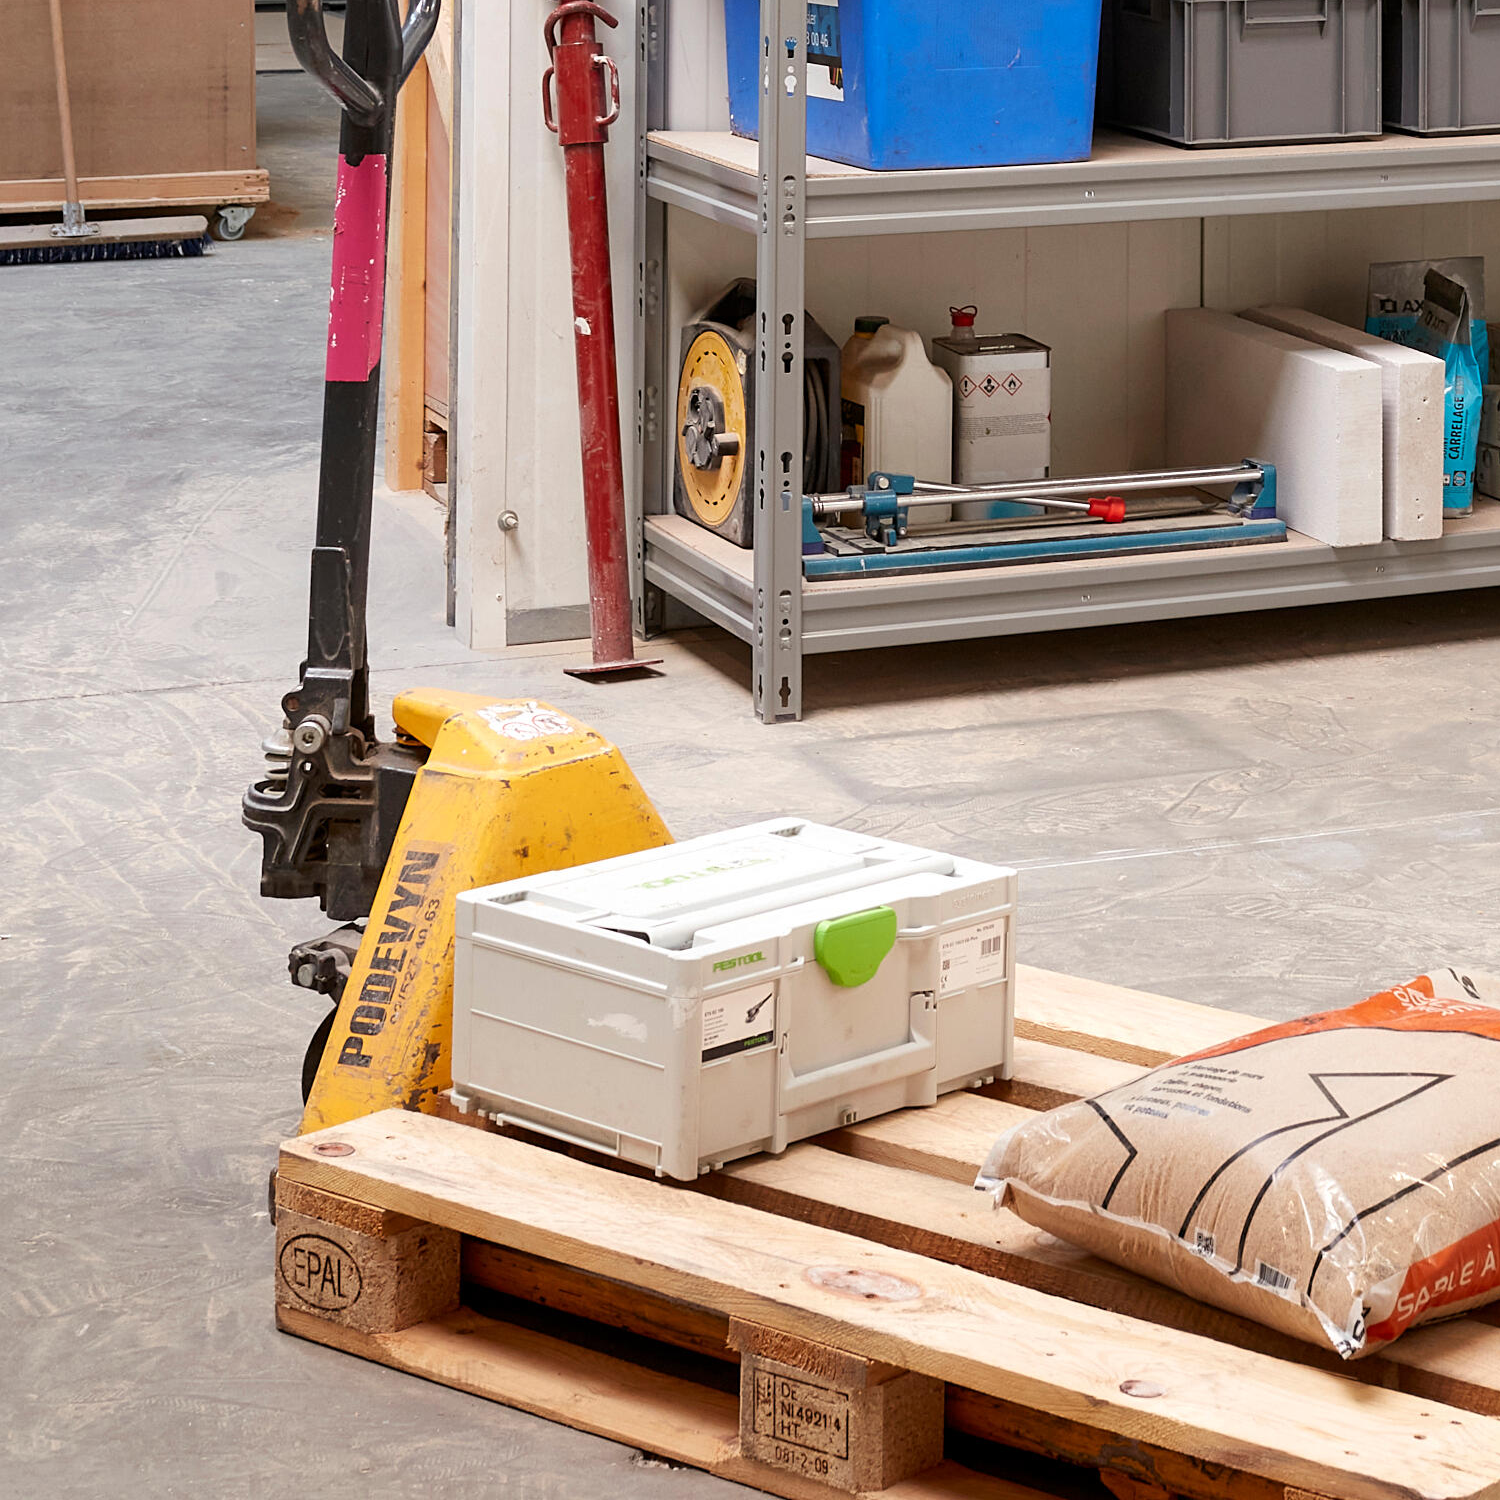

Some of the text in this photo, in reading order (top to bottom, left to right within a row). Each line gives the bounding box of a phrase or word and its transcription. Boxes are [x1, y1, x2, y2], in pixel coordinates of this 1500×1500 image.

[1403, 299, 1425, 313] AX
[1448, 396, 1465, 460] CARRELAGE
[337, 850, 441, 1068] PODEVYN
[712, 951, 767, 973] FESTOOL
[743, 1035, 768, 1047] FESTOOL
[1132, 1105, 1168, 1120] poteaux
[1203, 1094, 1252, 1113] fondations
[293, 1246, 347, 1298] EPAL
[1397, 1260, 1475, 1322] SABLE
[1481, 1244, 1497, 1277] À
[781, 1420, 801, 1439] HT
